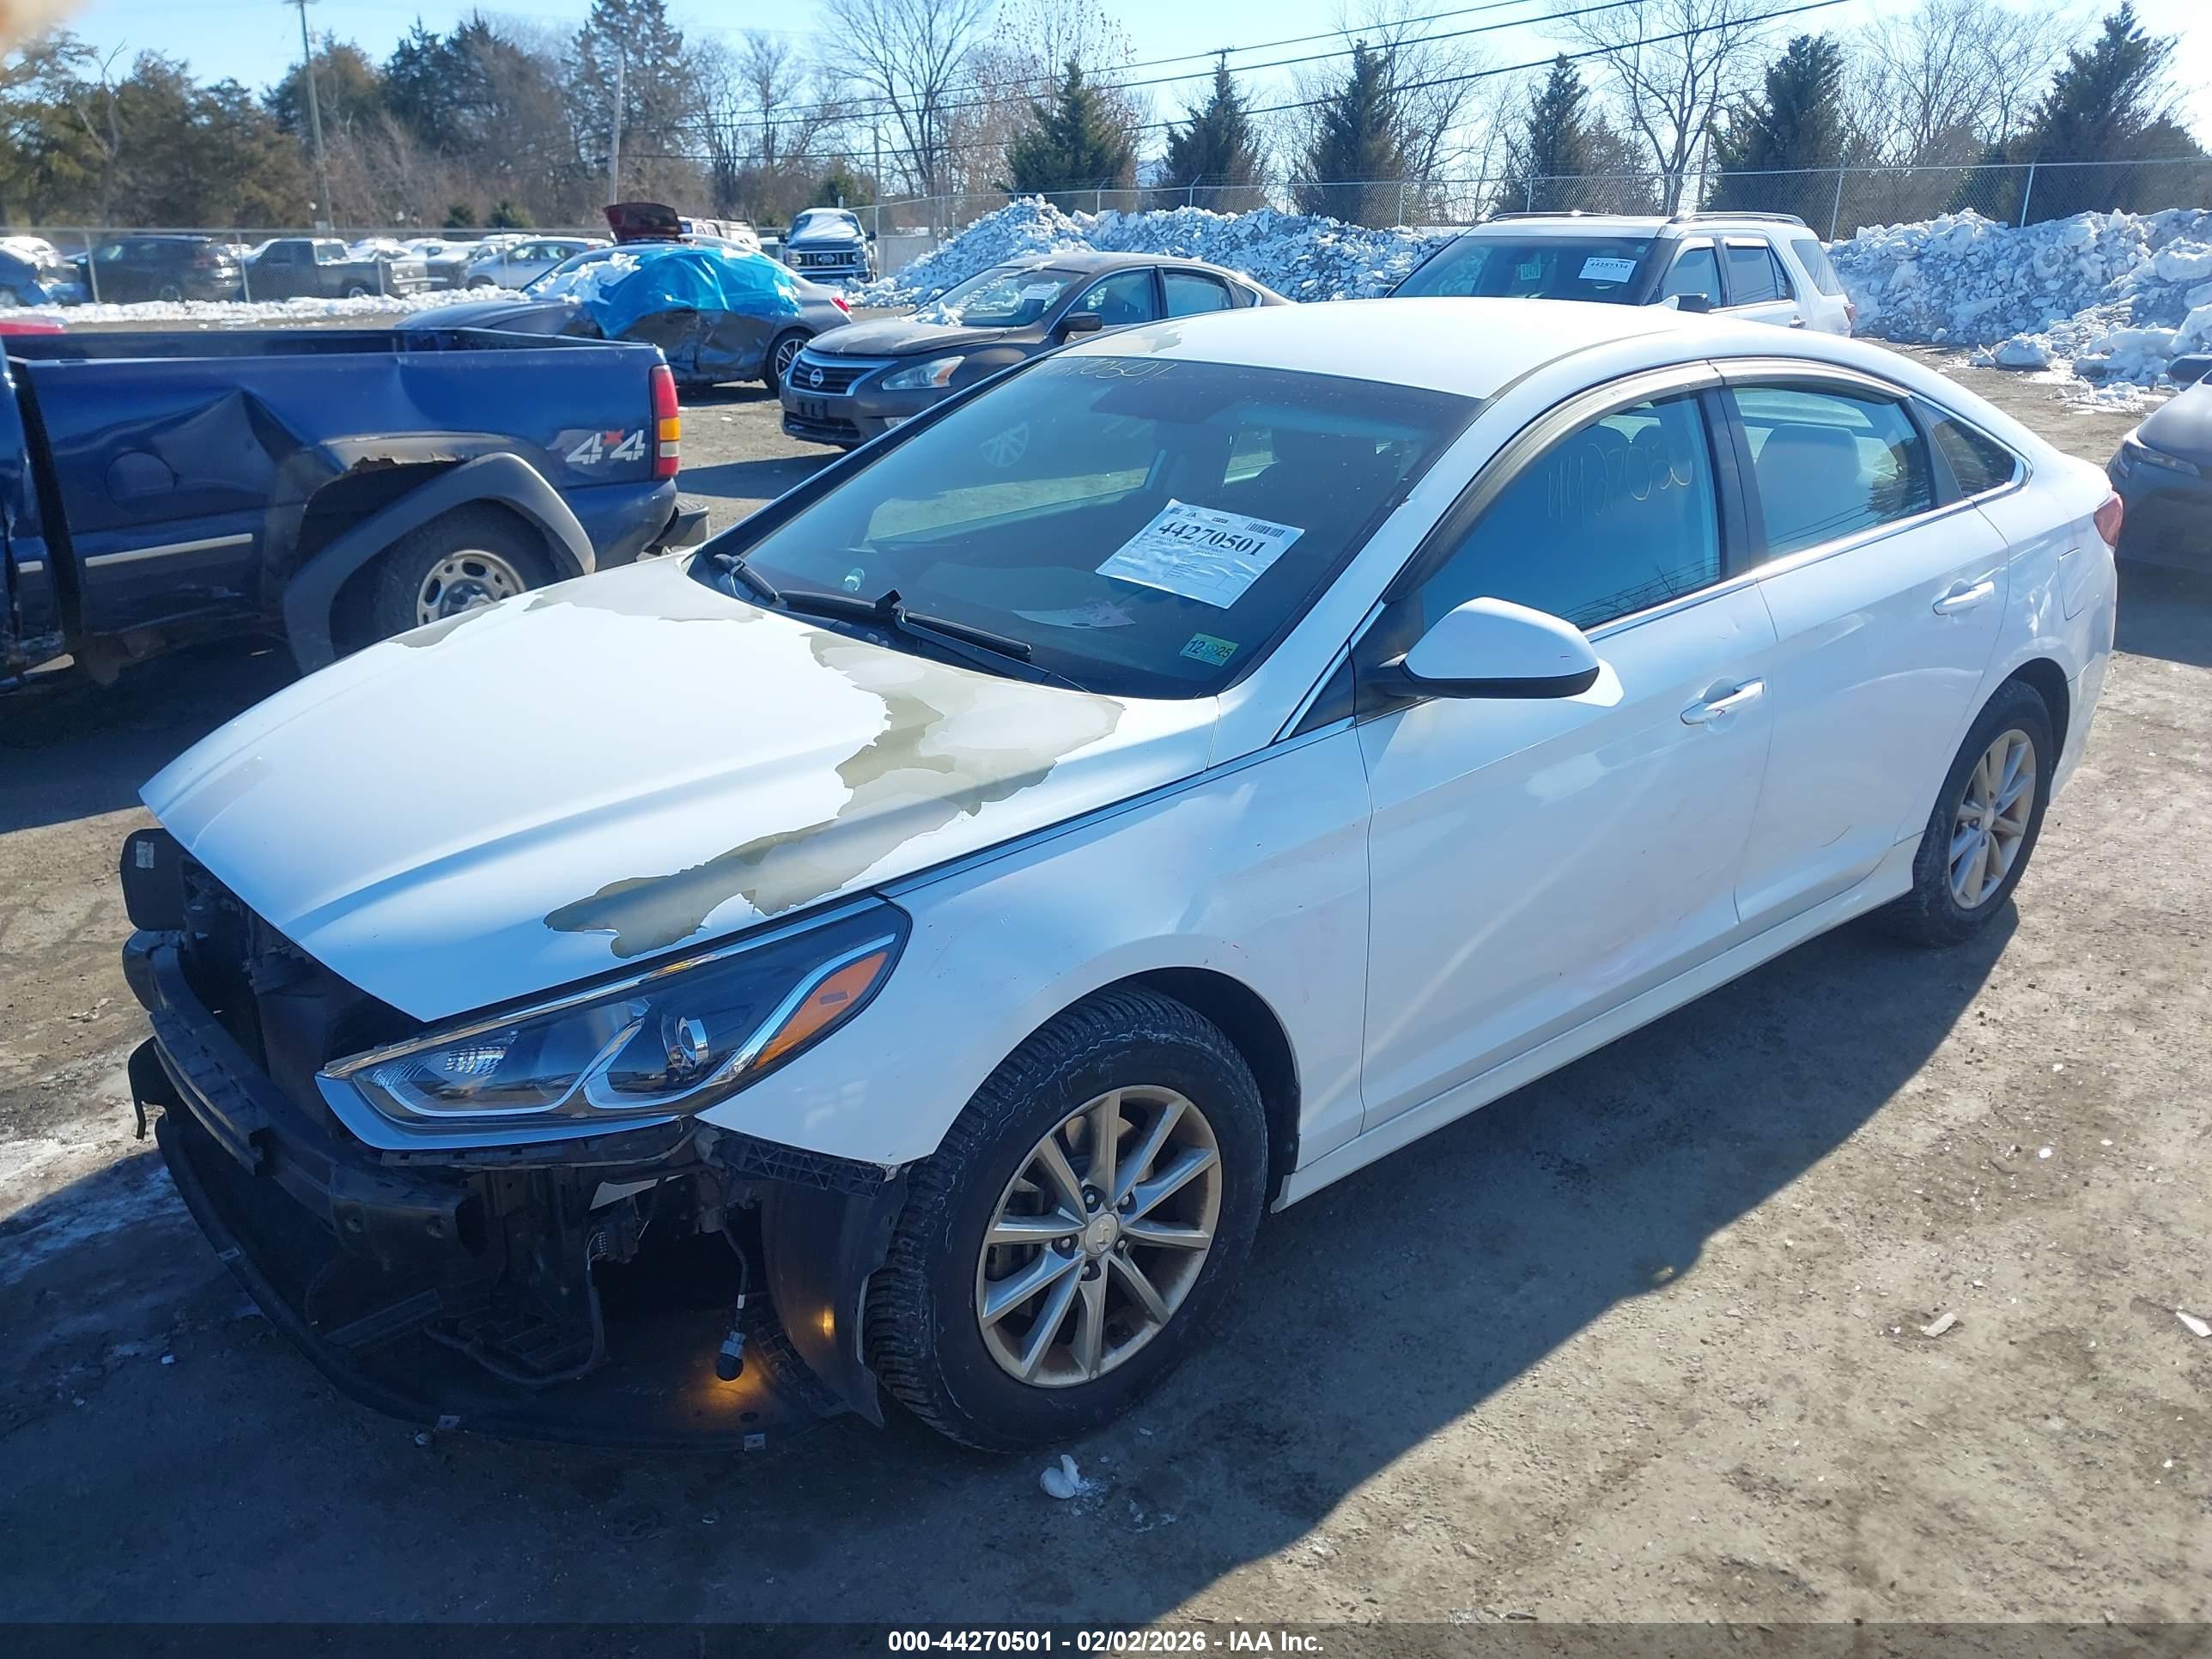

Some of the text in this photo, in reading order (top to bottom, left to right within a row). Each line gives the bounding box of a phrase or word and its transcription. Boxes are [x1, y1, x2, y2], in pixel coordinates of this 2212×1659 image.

[1158, 521, 1267, 556] 44270501
[1188, 640, 1233, 659] 12 25
